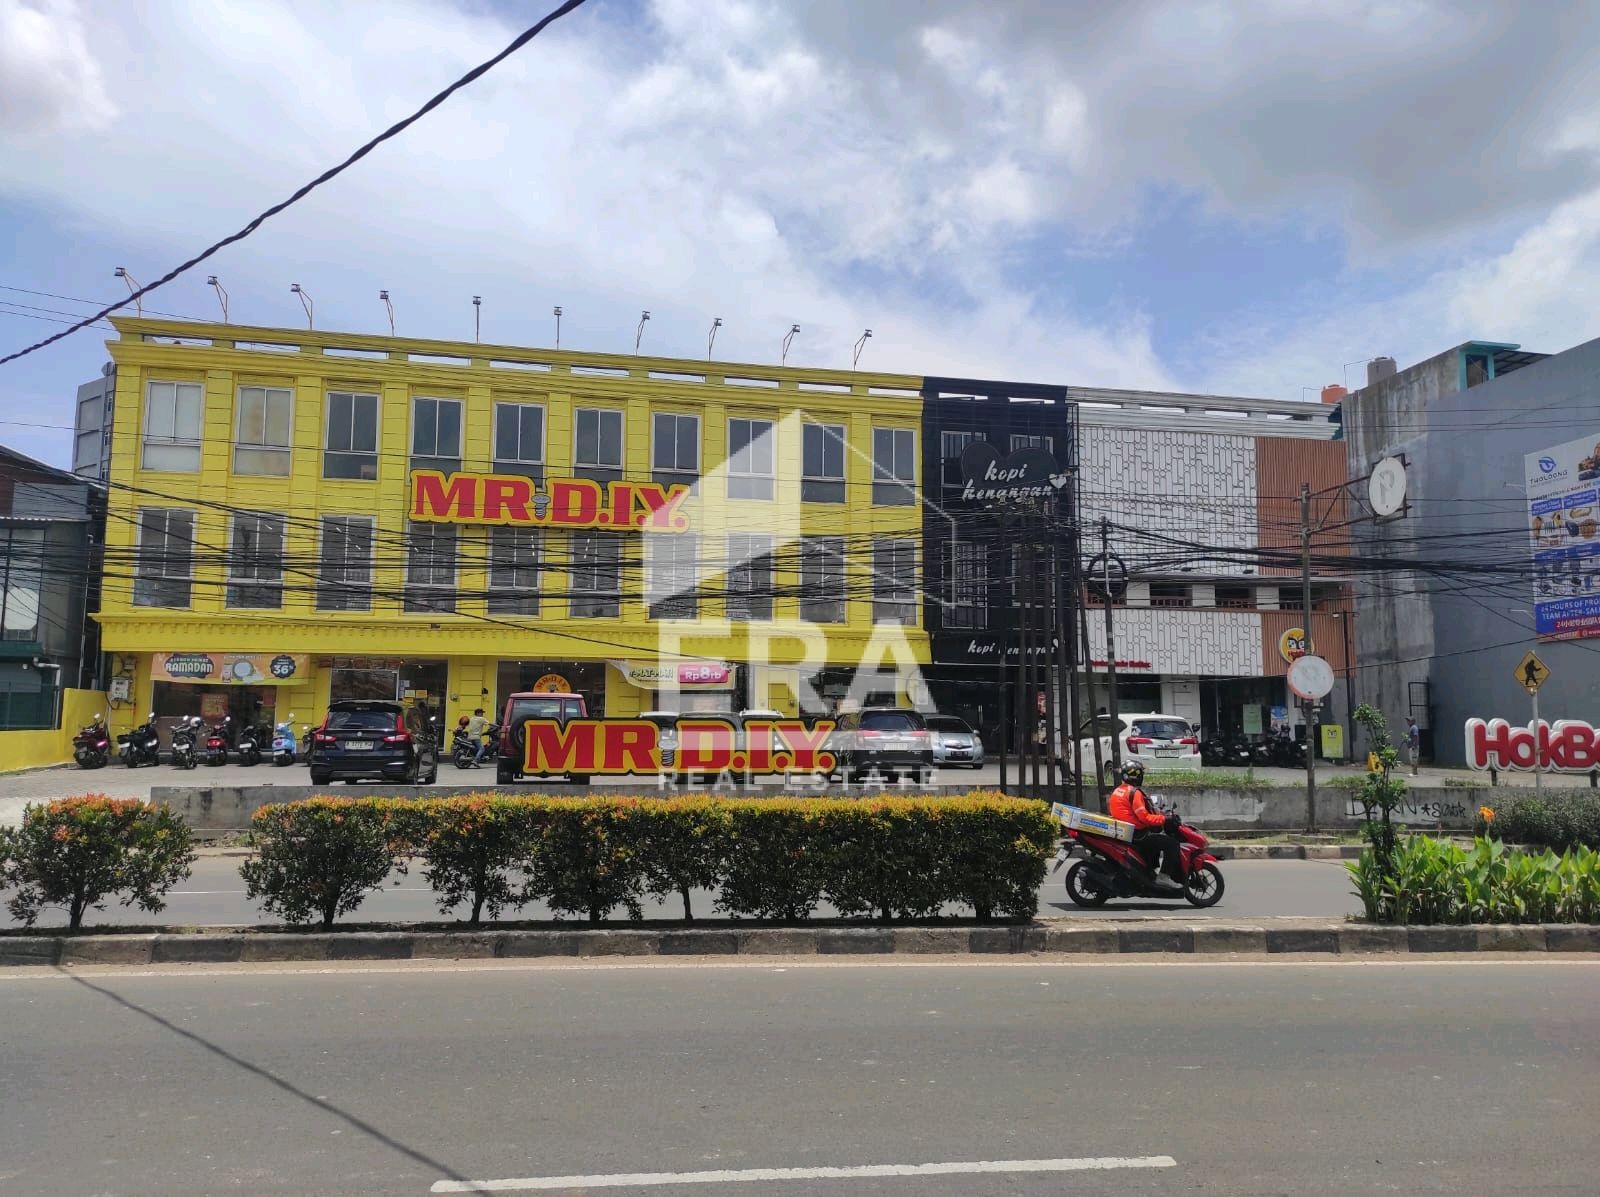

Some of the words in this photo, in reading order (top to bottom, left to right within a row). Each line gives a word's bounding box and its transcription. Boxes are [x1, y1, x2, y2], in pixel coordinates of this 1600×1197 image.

[985, 460, 1027, 482] kopi
[415, 474, 530, 521] MR
[961, 478, 1053, 502] kenangan
[967, 639, 996, 655] kopi
[165, 662, 214, 673] RAMADAN
[527, 723, 658, 769] MR
[1473, 723, 1600, 768] HokB
